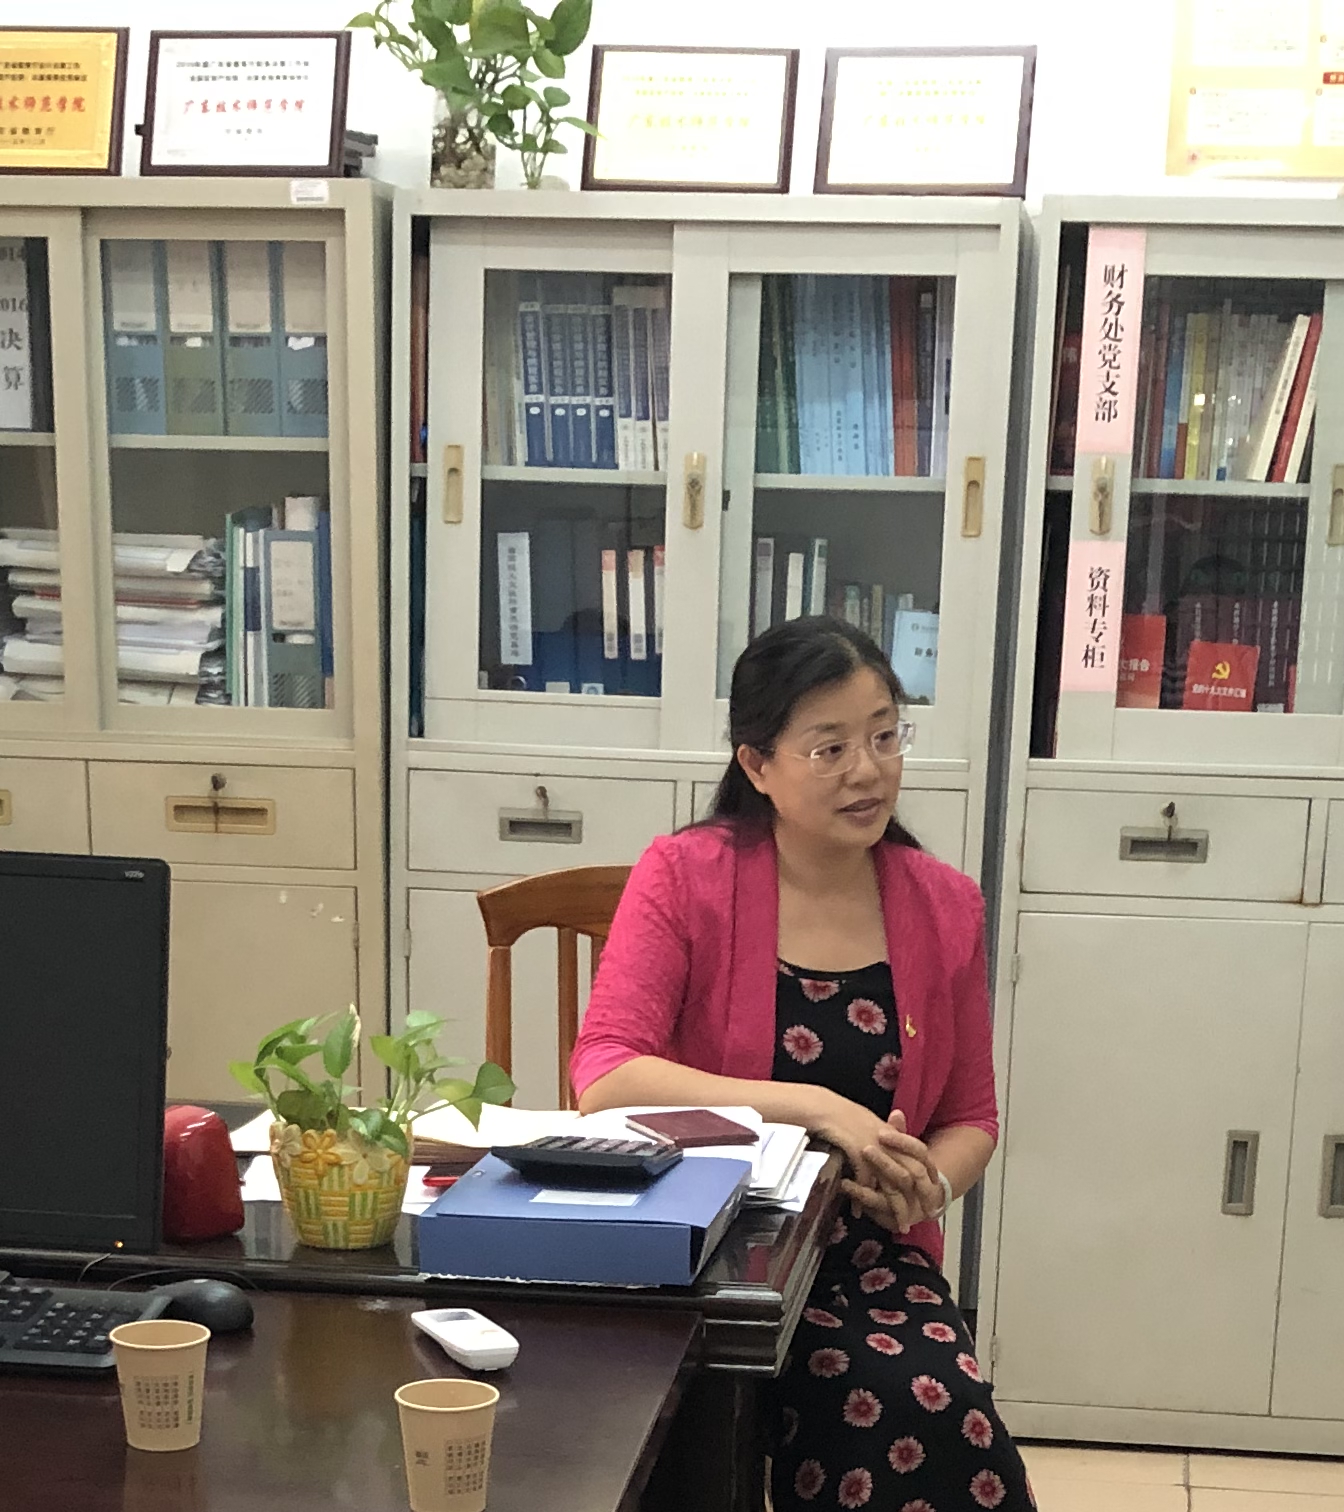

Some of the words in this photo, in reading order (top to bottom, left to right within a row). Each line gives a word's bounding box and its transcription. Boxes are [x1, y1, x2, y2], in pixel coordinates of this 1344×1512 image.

[0, 327, 25, 391] 决算
[1094, 263, 1129, 424] 财务处党支部
[1081, 565, 1111, 671] 资料专柜
